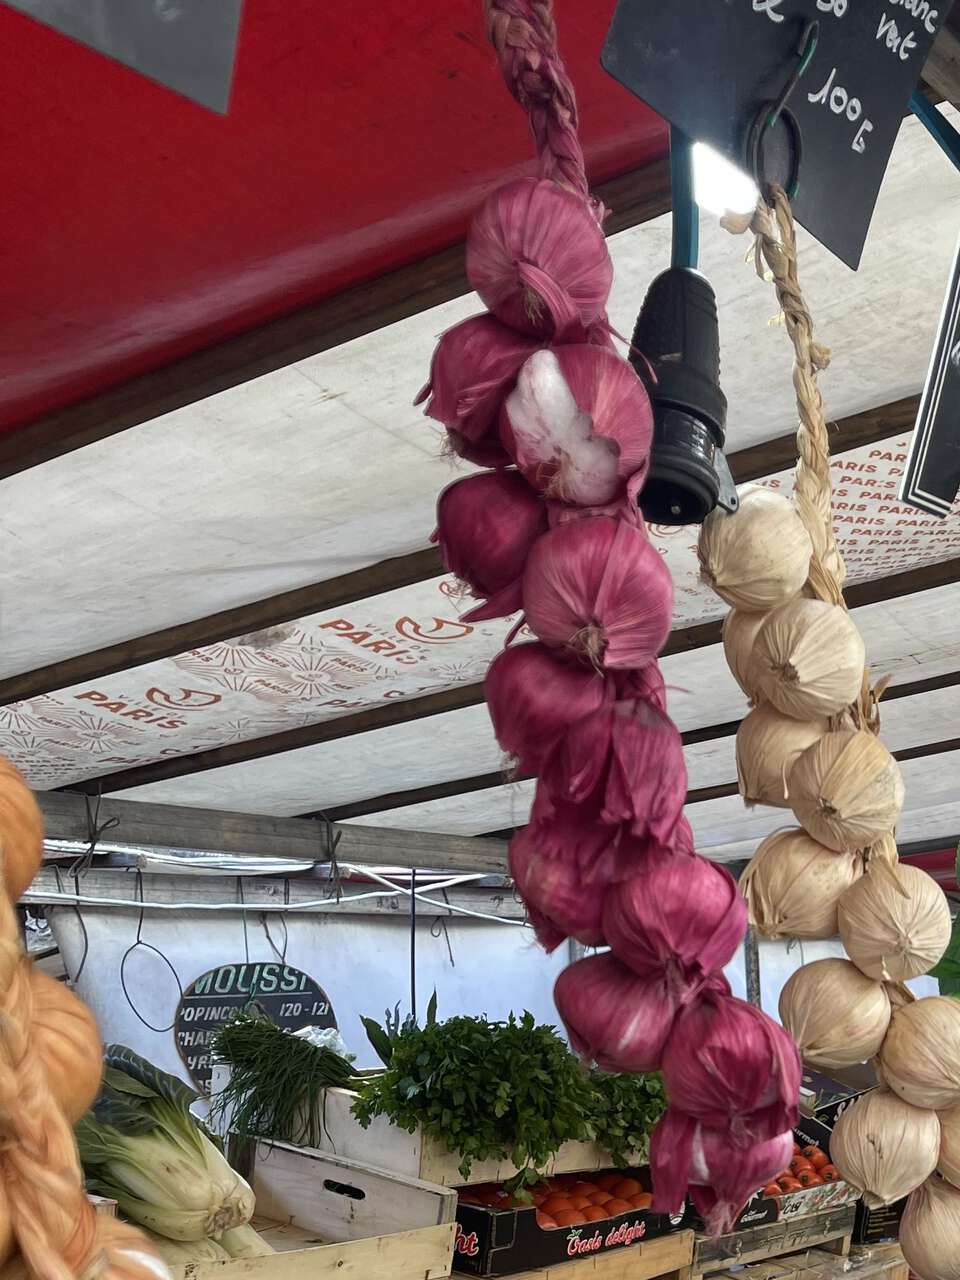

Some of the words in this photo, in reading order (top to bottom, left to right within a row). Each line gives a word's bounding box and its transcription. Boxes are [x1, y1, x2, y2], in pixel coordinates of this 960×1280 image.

[807, 68, 862, 121] 100
[831, 460, 877, 473] ARIS
[869, 450, 907, 463] PAR
[831, 502, 868, 513] ARIS
[318, 618, 418, 665] PARIS
[74, 690, 188, 729] PARIS
[279, 1003, 301, 1017] 120
[567, 1230, 602, 1256] Oasis
[605, 1220, 646, 1247] delight
